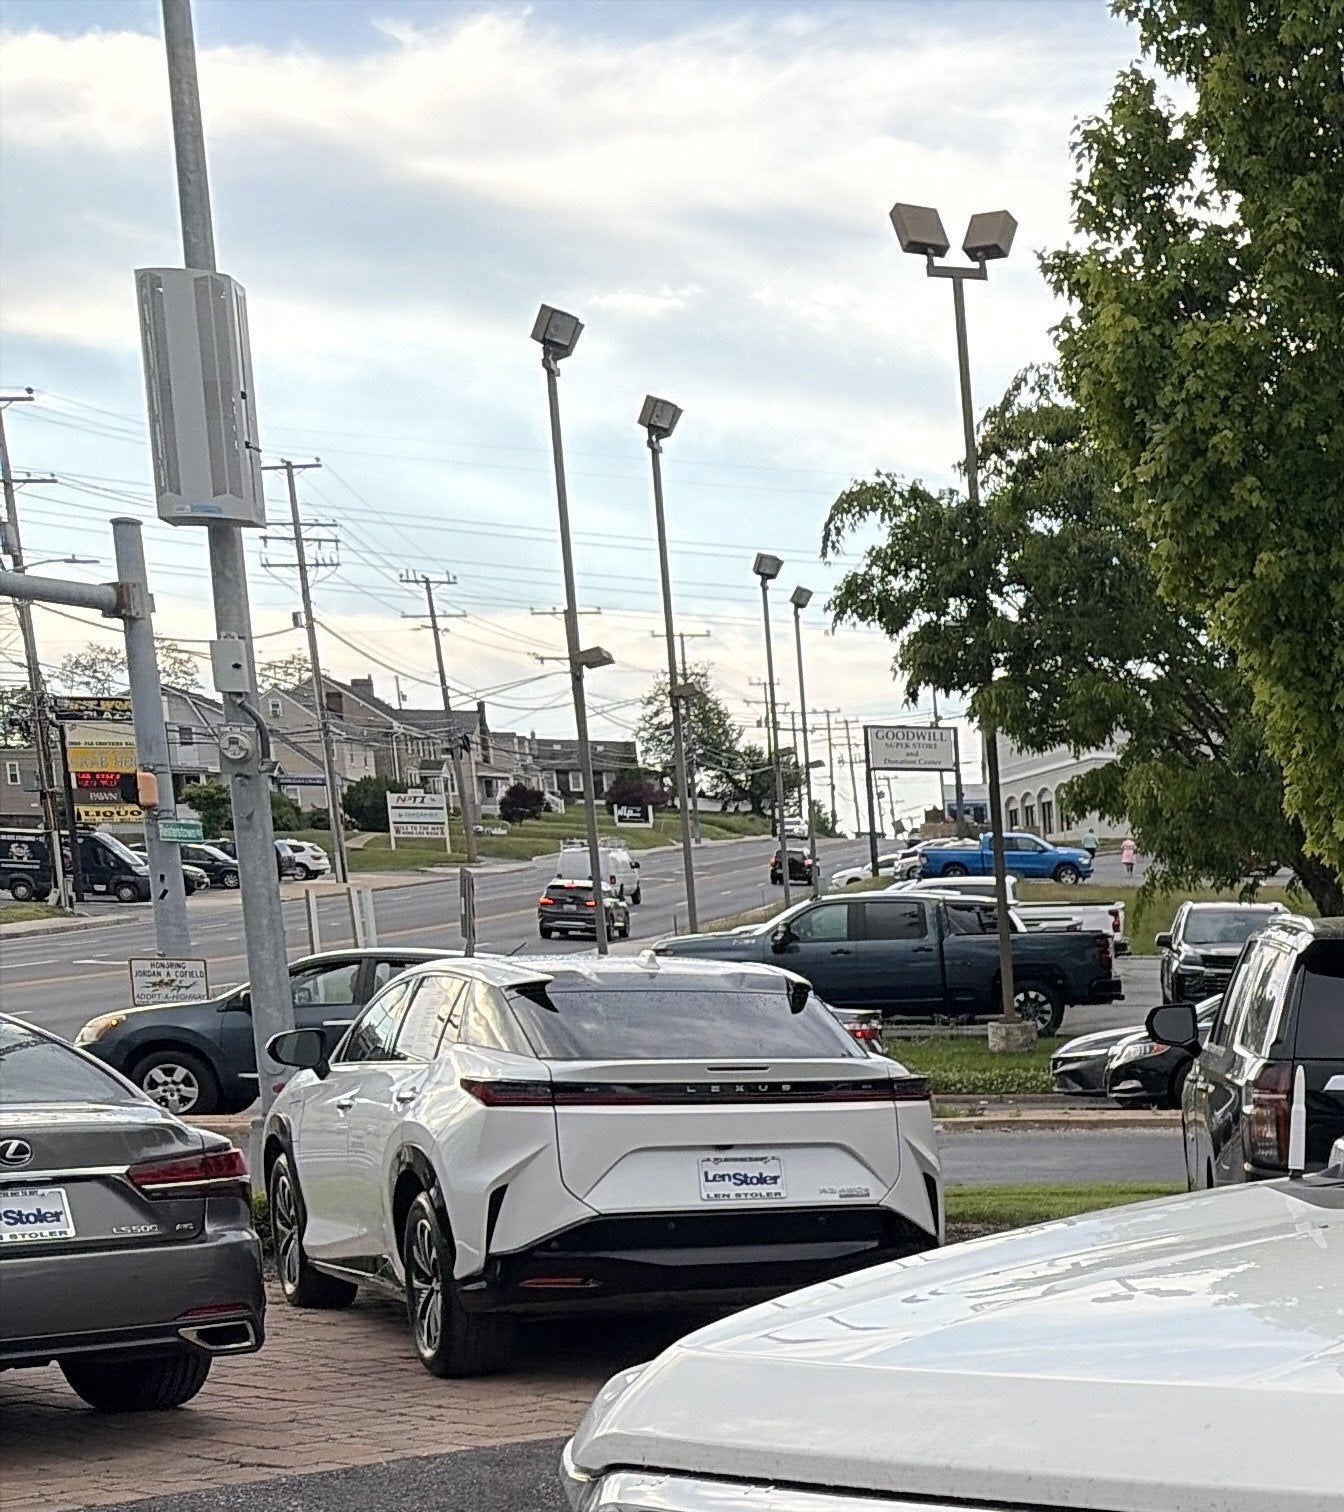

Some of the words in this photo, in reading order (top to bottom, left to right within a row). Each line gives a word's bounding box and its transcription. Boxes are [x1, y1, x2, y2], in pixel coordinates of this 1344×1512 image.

[875, 729, 947, 742] GOODWILL
[885, 742, 910, 750] SUPER
[912, 742, 937, 750] STORE
[134, 970, 162, 978] JORDAN
[174, 970, 205, 979] COFIELD
[686, 1084, 792, 1093] LEXUS
[706, 1192, 731, 1200] LEN
[734, 1191, 782, 1199] STOLER
[9, 1229, 69, 1240] STOLER
